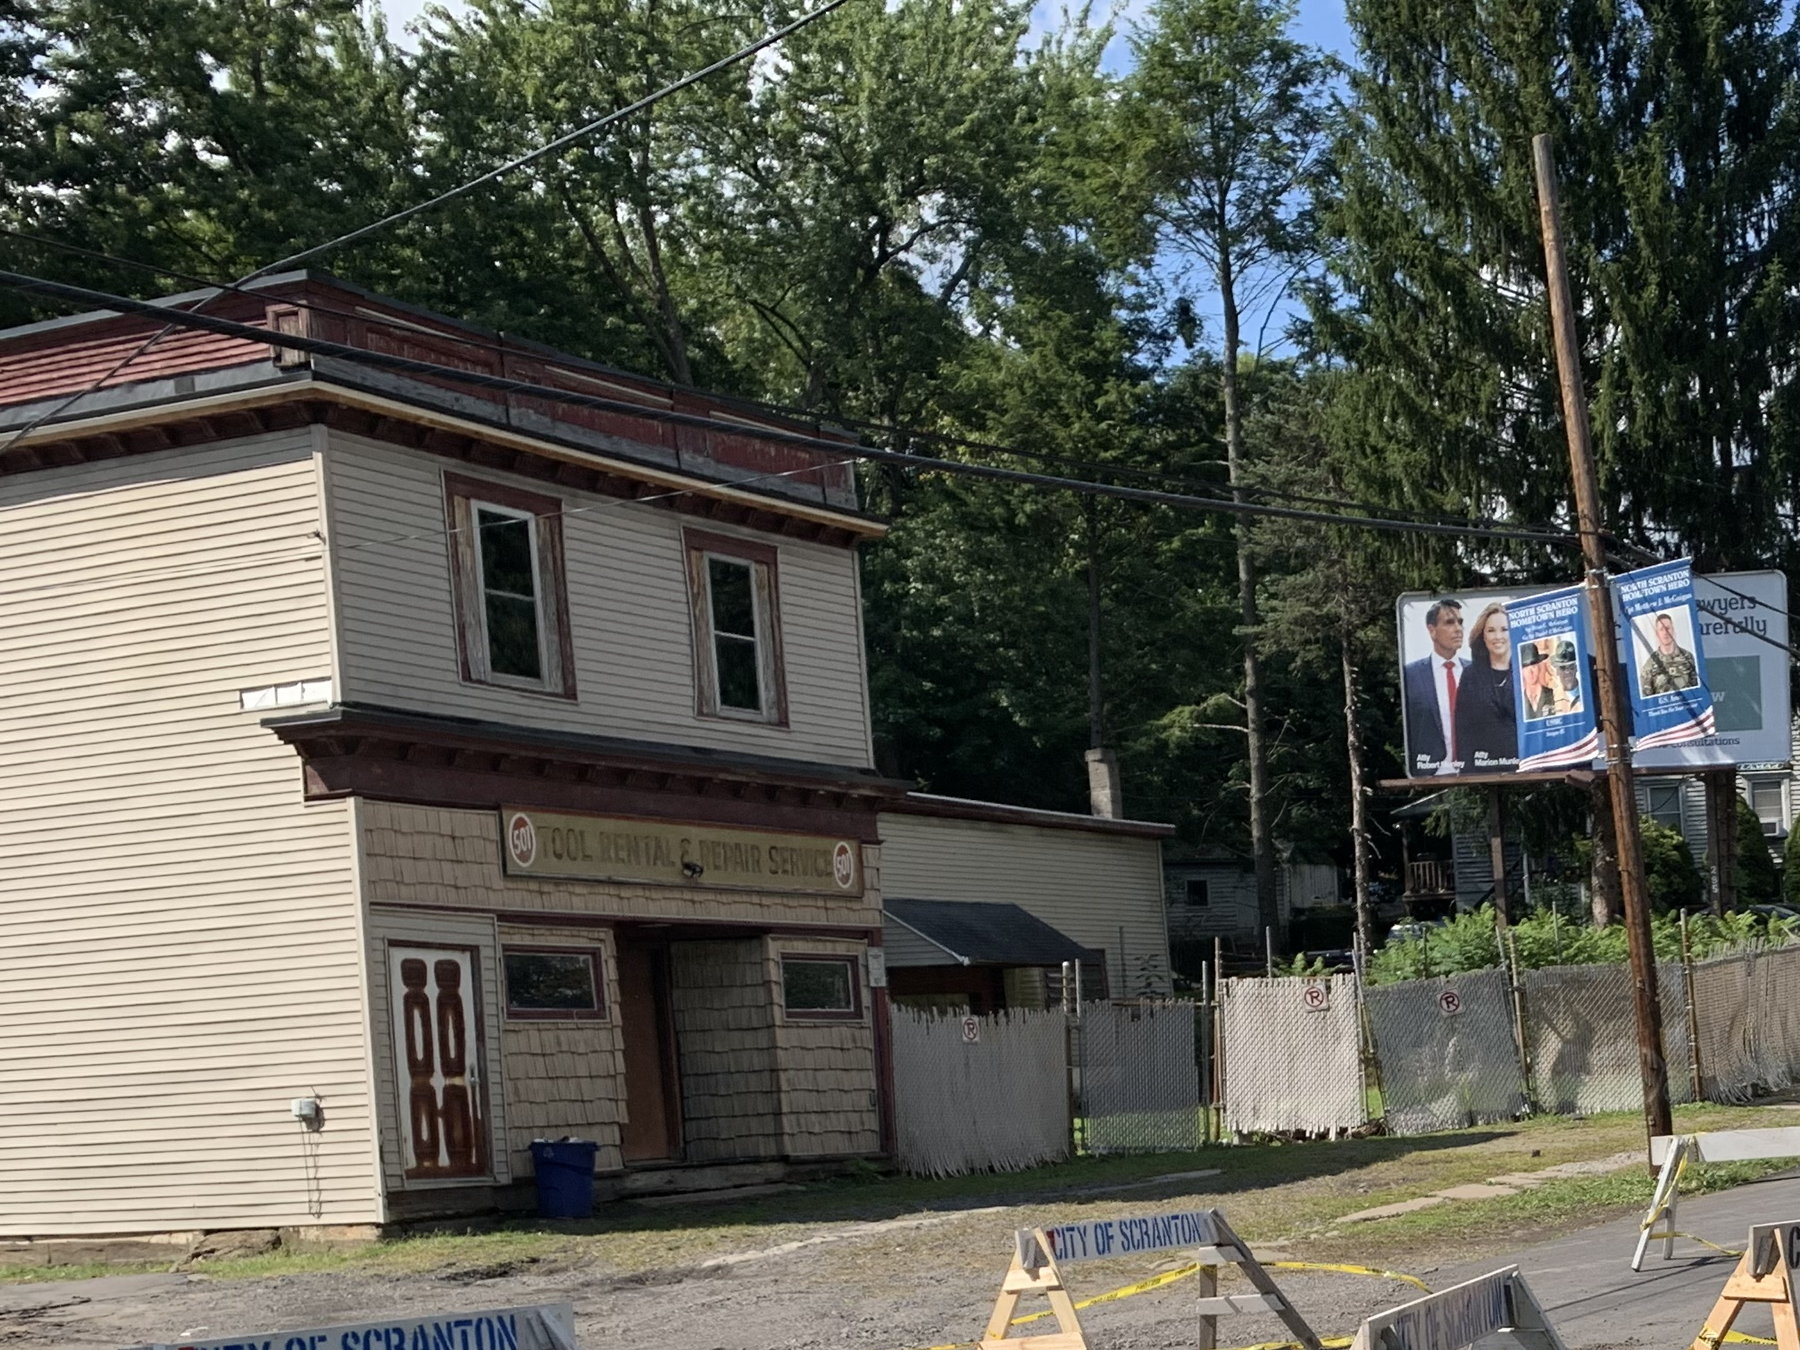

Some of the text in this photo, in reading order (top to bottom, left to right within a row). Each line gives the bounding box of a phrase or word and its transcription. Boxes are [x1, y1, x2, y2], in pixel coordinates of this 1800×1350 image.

[1648, 569, 1690, 587] SCRANTON
[1668, 578, 1691, 591] HERO
[1508, 597, 1578, 620] NORTH SCRANTON
[1510, 606, 1578, 629] HOMETOWN HERO
[1499, 757, 1521, 765] Munle
[538, 824, 592, 863] TOOL
[599, 829, 676, 868] RENTAL
[701, 840, 761, 875] REPAIR
[768, 844, 835, 878] SERVICE
[1051, 1213, 1202, 1261] CITY OF SCRANTON
